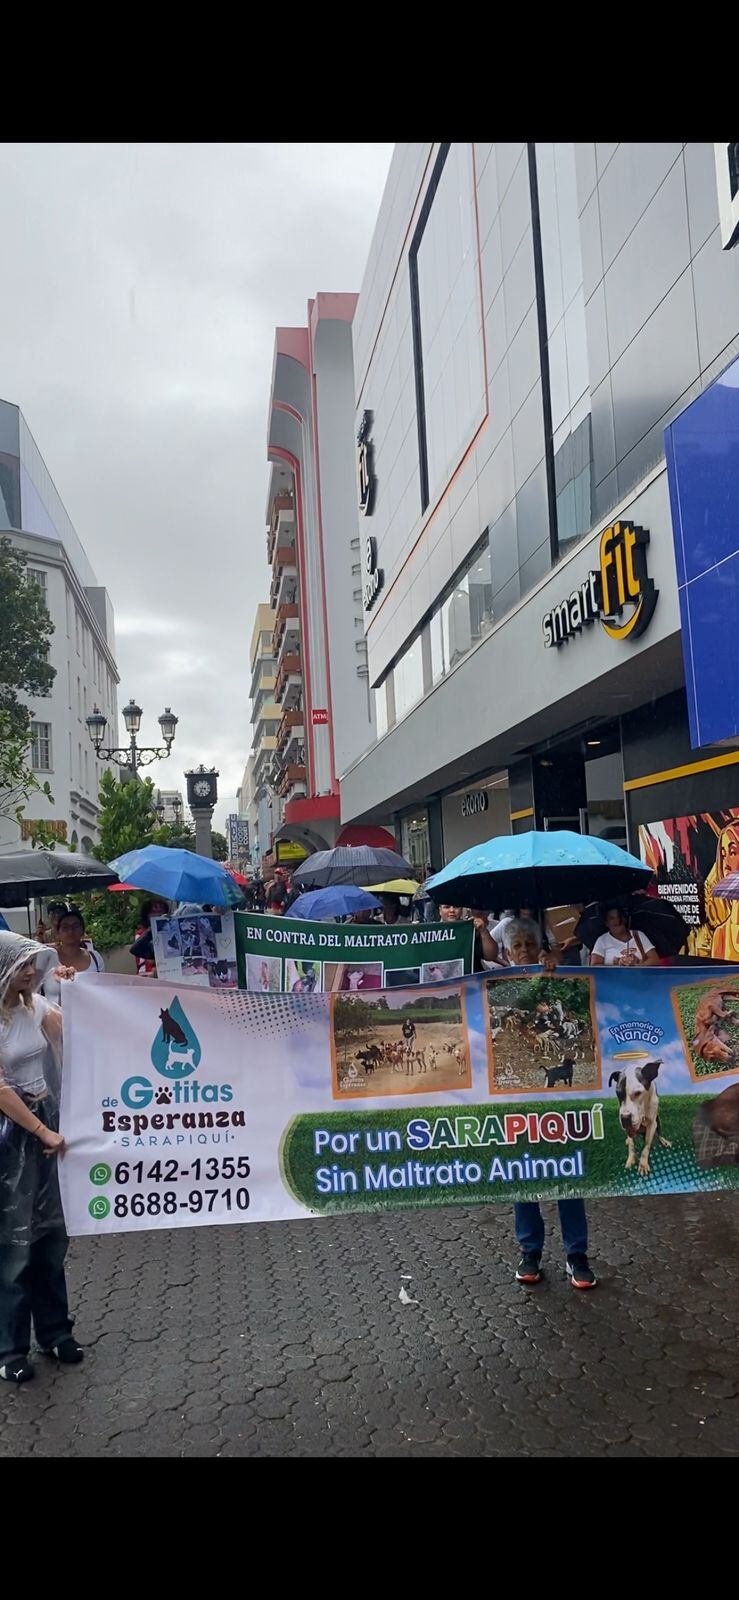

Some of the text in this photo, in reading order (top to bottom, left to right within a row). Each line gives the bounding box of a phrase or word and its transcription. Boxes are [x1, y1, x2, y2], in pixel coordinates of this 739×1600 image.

[543, 521, 641, 648] smart fit
[461, 791, 486, 817] ekono
[657, 883, 698, 895] BIENVENIDOS
[691, 904, 700, 914] DE
[246, 926, 456, 948] EN CONTRA DEL MALTRATO ANIMAL
[609, 1021, 664, 1037] En memoria de
[615, 1030, 659, 1044] Nando
[101, 1097, 118, 1107] de
[102, 1110, 246, 1136] Esperanza
[314, 1103, 605, 1155] Por un SARAPIQUÍ
[121, 1130, 229, 1147] SARAPIQUÍ
[114, 1156, 251, 1185] 6142-1355
[316, 1151, 584, 1193] Sin Maltrato Animal
[113, 1187, 250, 1218] 8688-9710
